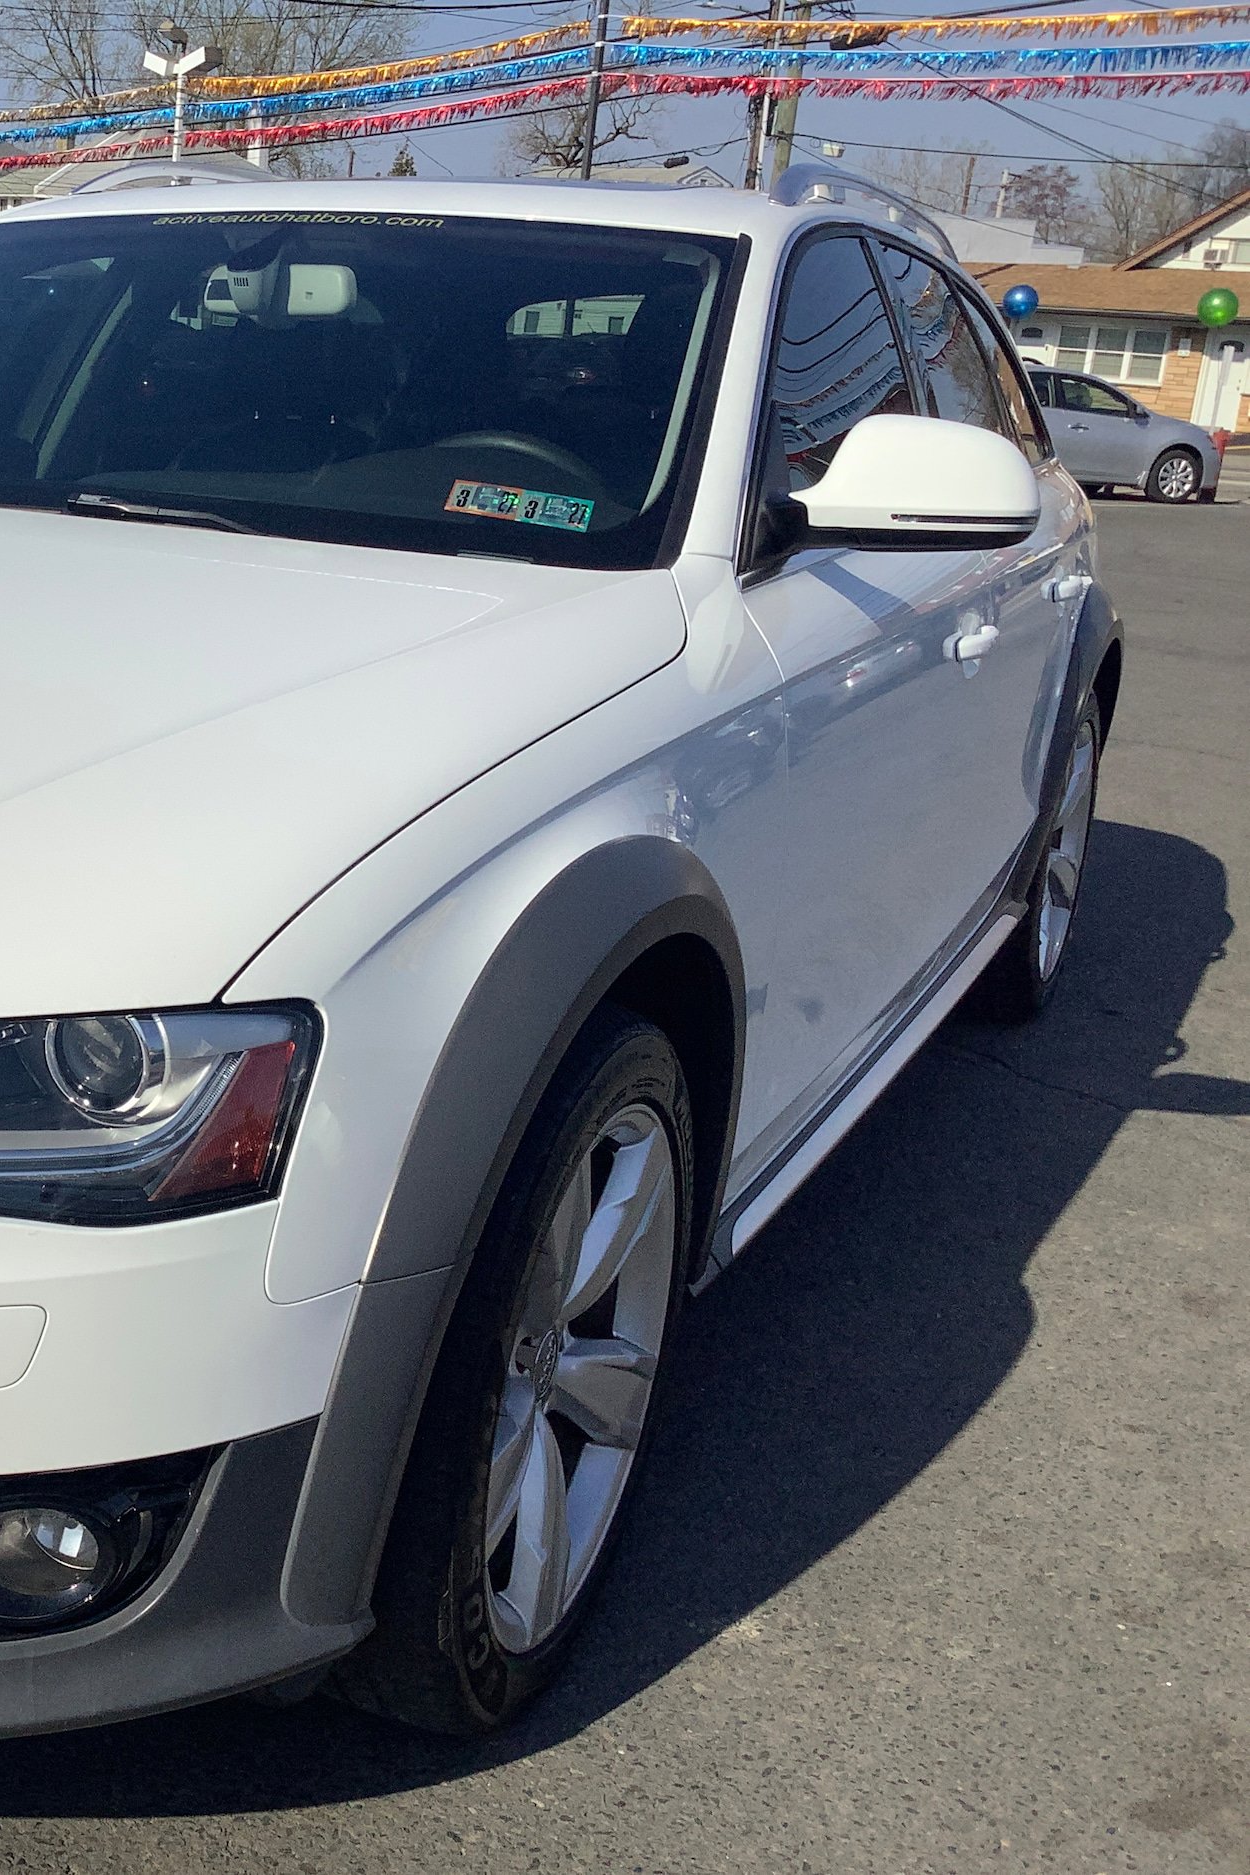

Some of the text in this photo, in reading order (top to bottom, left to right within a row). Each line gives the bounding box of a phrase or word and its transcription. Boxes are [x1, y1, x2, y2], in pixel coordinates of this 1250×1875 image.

[152, 212, 445, 229] activeautohatboro.com
[456, 489, 471, 508] 3
[524, 500, 539, 519] 3
